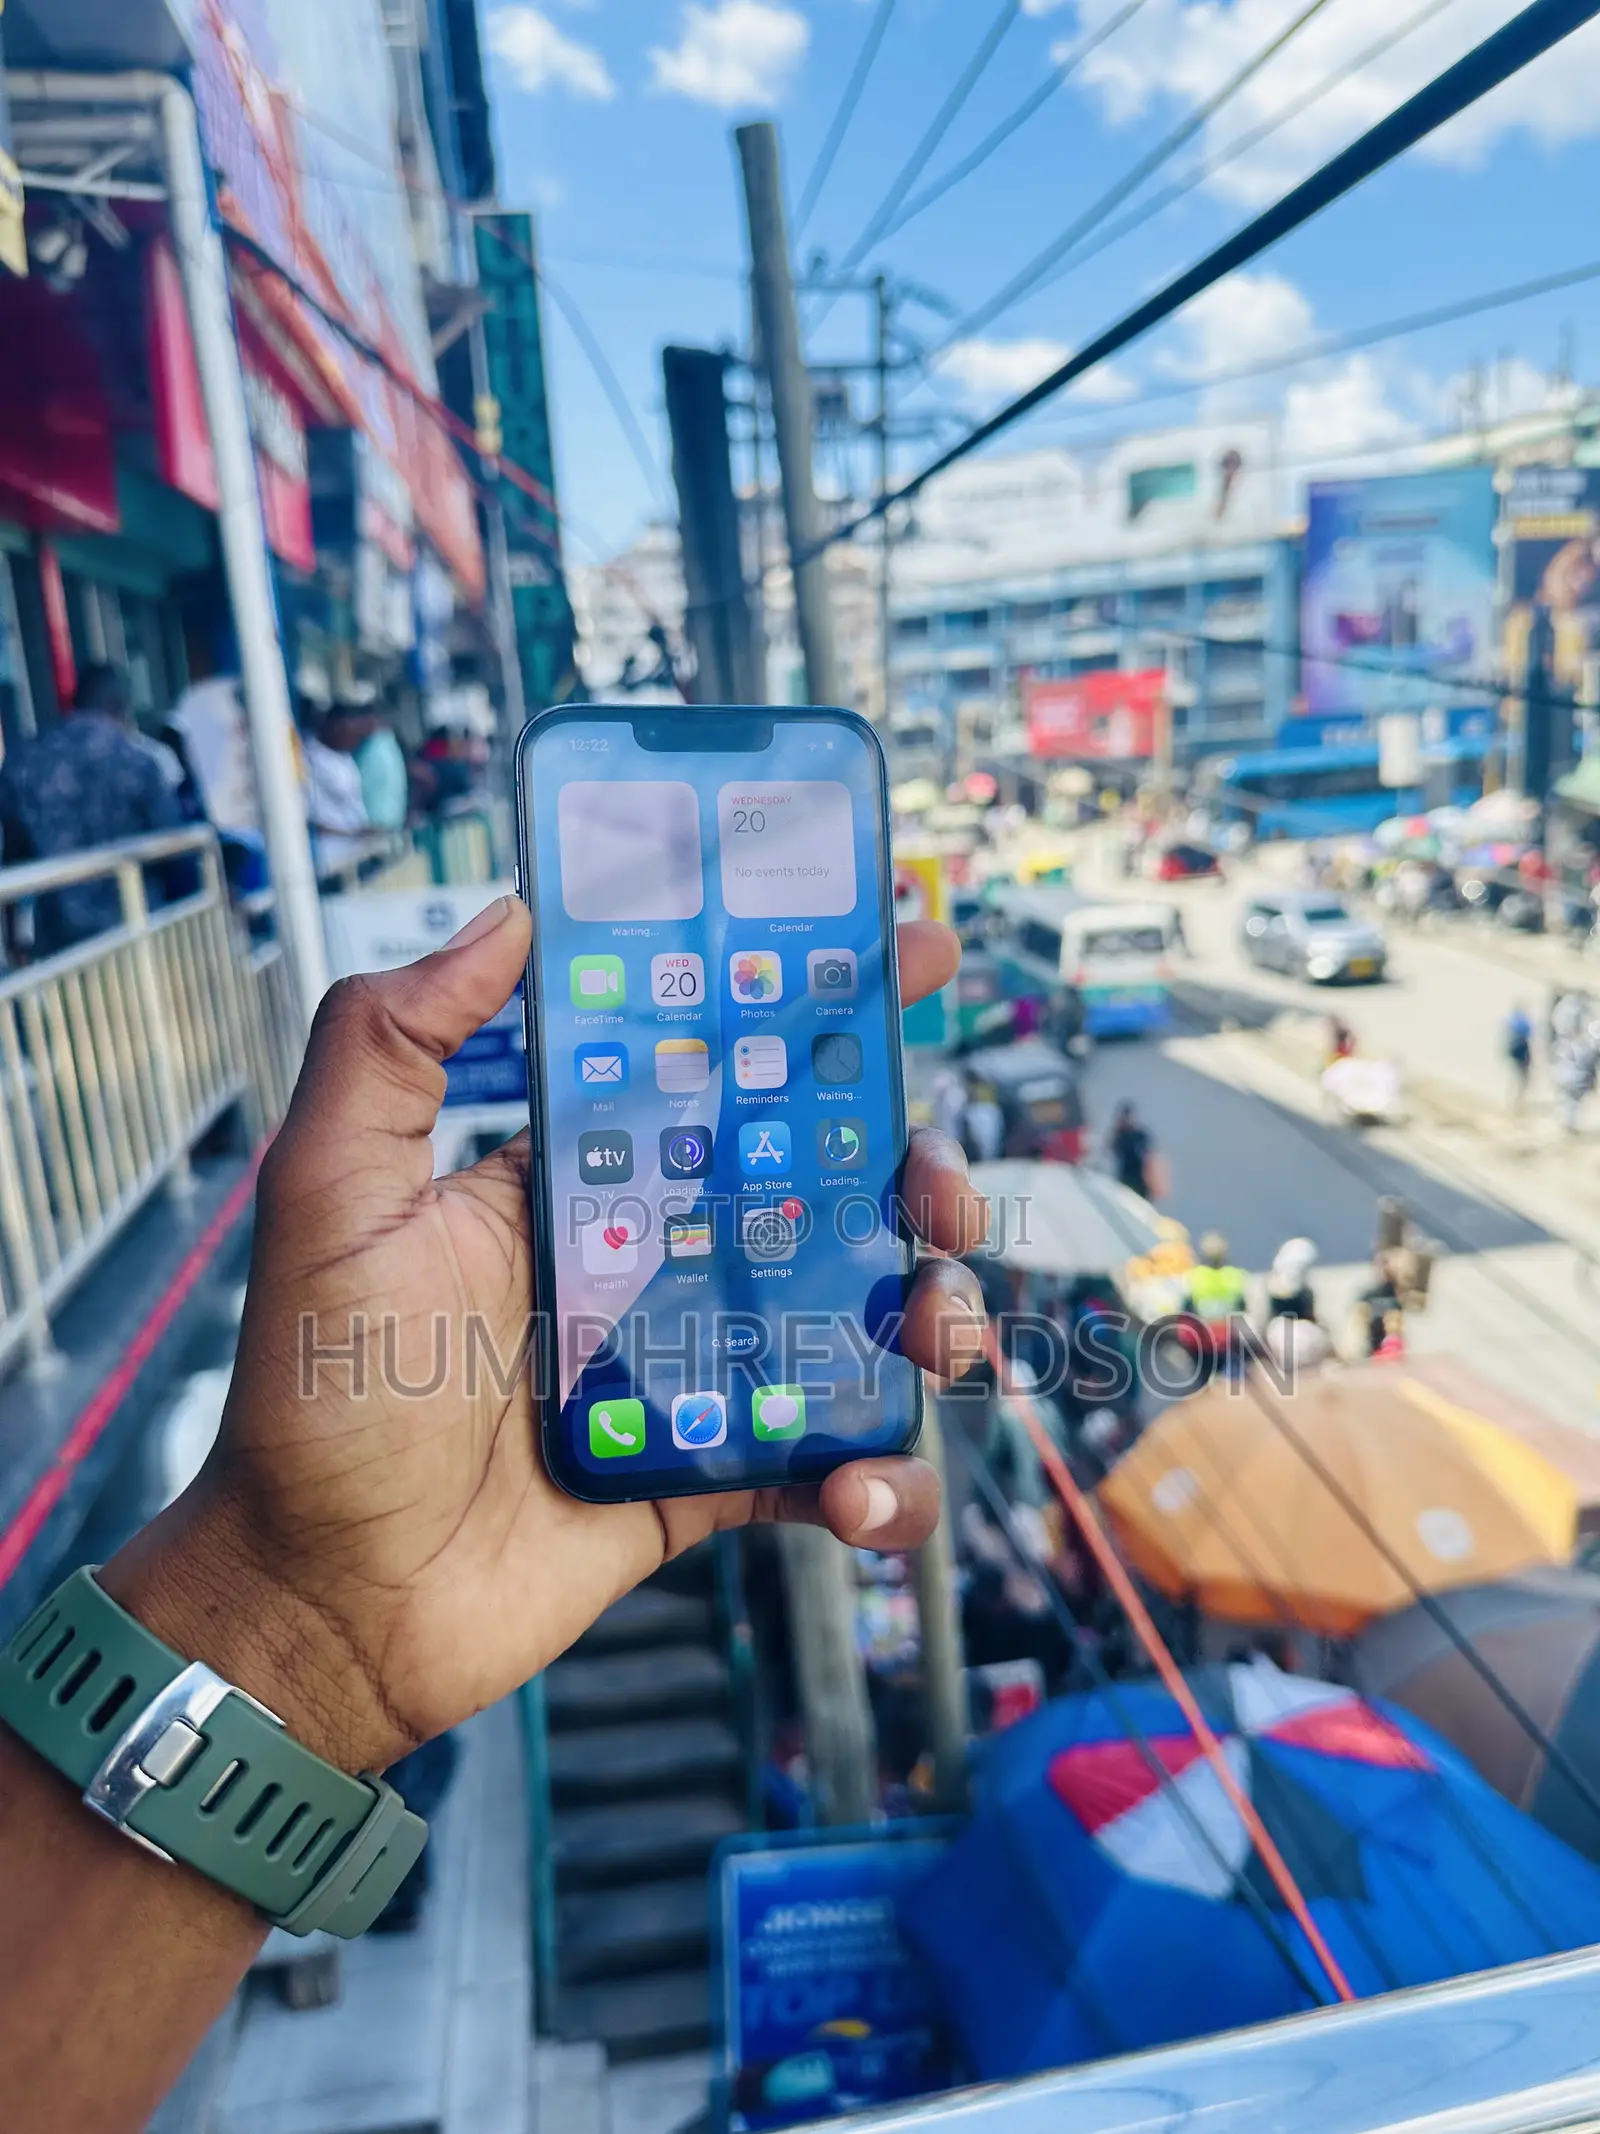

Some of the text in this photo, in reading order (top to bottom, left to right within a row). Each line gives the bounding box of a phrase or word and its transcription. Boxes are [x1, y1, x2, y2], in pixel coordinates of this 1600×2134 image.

[570, 739, 609, 751] 12:22
[731, 796, 792, 805] WEDNESDAY
[733, 810, 766, 833] 20
[735, 865, 830, 877] No events today
[769, 923, 814, 932] Calendar
[665, 959, 689, 968] WED
[659, 972, 697, 998] 20
[740, 1009, 776, 1018] Photos
[815, 1006, 853, 1016] Camera
[574, 1014, 624, 1025] FaceTime
[656, 1012, 702, 1022] Calendar
[669, 1099, 700, 1108] Notes
[736, 1094, 789, 1105] Reminders
[593, 1102, 614, 1113] Mail
[603, 1149, 626, 1166] tv
[742, 1180, 792, 1192] App Store
[600, 1190, 615, 1200] TV
[789, 1202, 796, 1214] 1
[676, 1274, 709, 1284] Wallet
[750, 1268, 793, 1279] Settings
[594, 1280, 629, 1290] Health
[724, 1336, 760, 1347] Search
